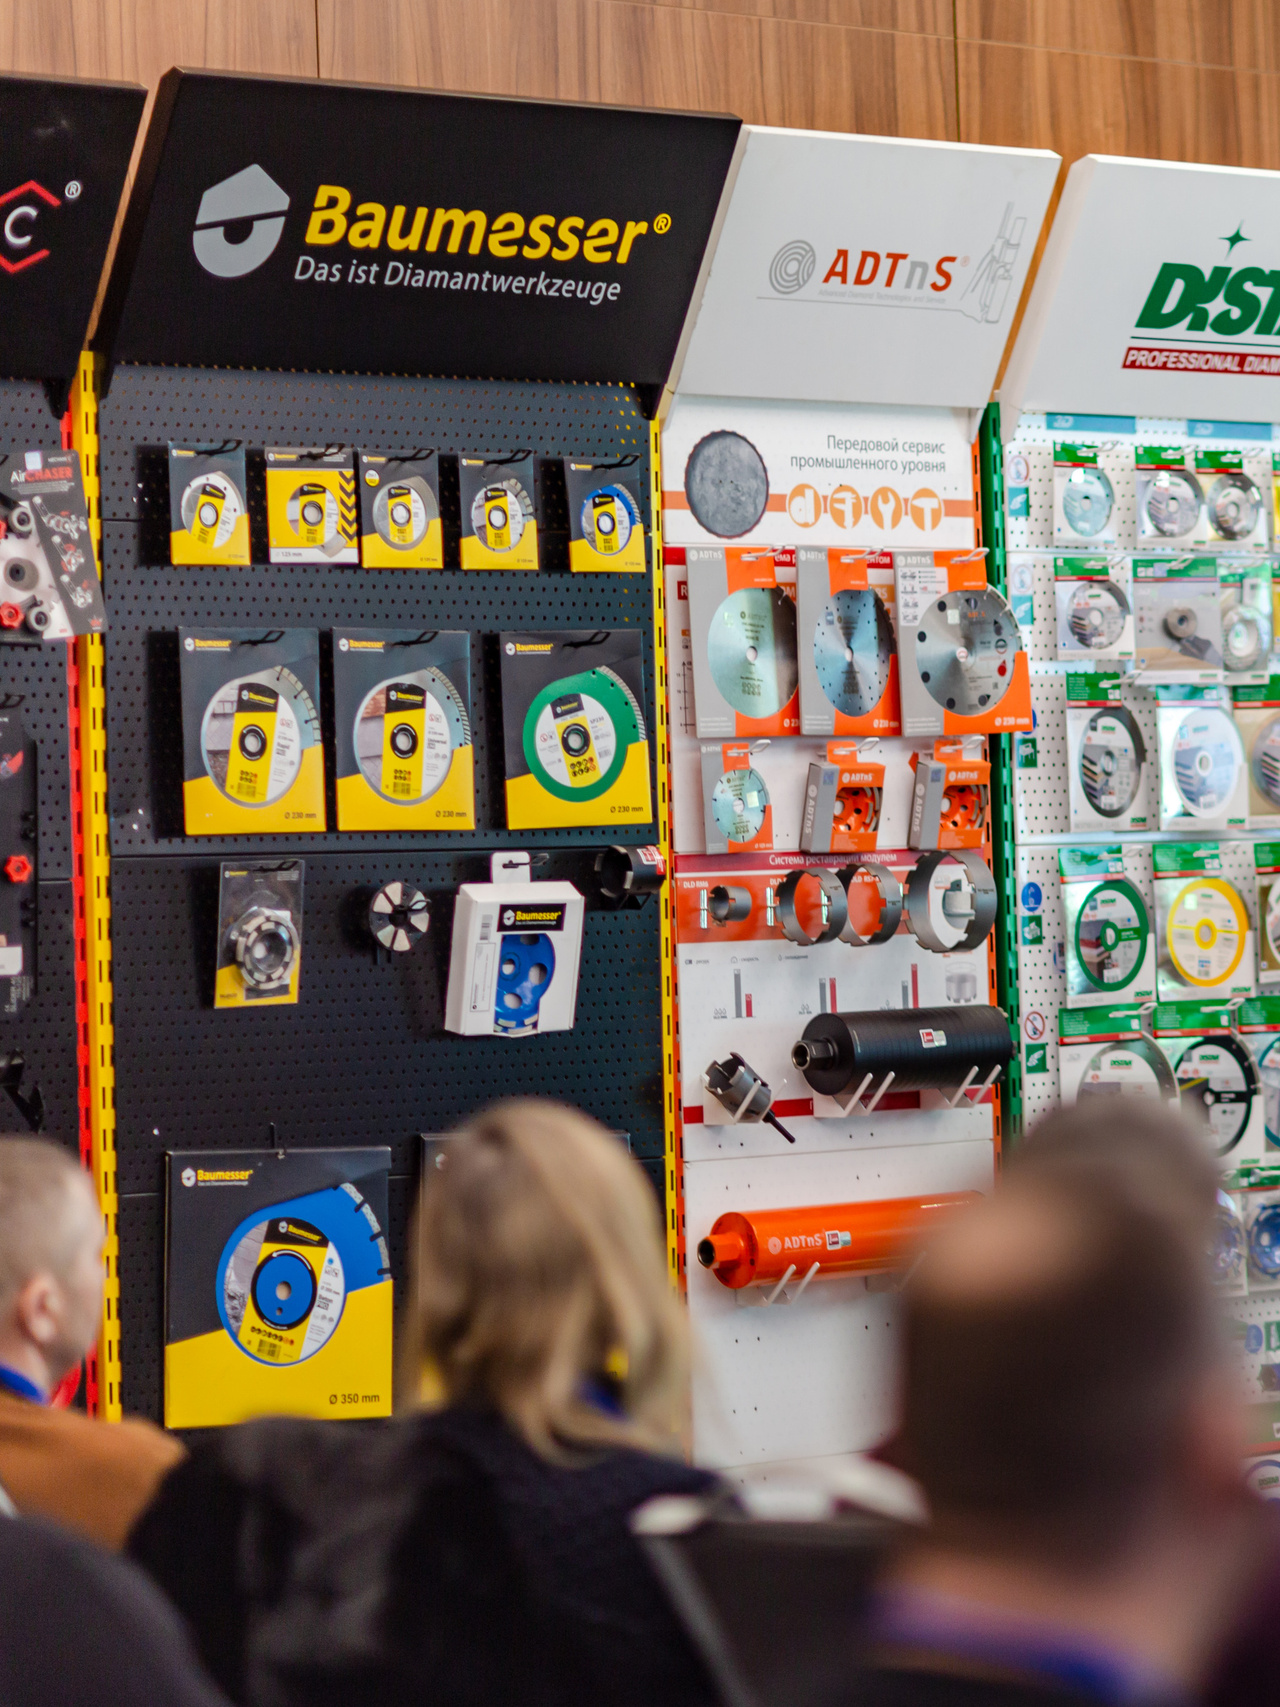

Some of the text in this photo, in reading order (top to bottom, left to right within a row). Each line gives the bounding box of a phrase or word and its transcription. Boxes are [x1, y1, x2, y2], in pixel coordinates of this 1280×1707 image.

[821, 248, 958, 292] ADTnS
[294, 255, 621, 305] Das ist Diamantwerkzeuge
[1125, 350, 1242, 372] PROFESSIONAL
[827, 434, 945, 457] Передовой сервис
[790, 455, 946, 475] промышленного уровня
[617, 805, 630, 813] 230
[769, 854, 804, 866] Система
[860, 852, 897, 864] модулем
[197, 1169, 250, 1181] Baumesser
[784, 1233, 822, 1249] ADTnS
[340, 1393, 359, 1404] 350
[361, 1394, 380, 1403] mm
